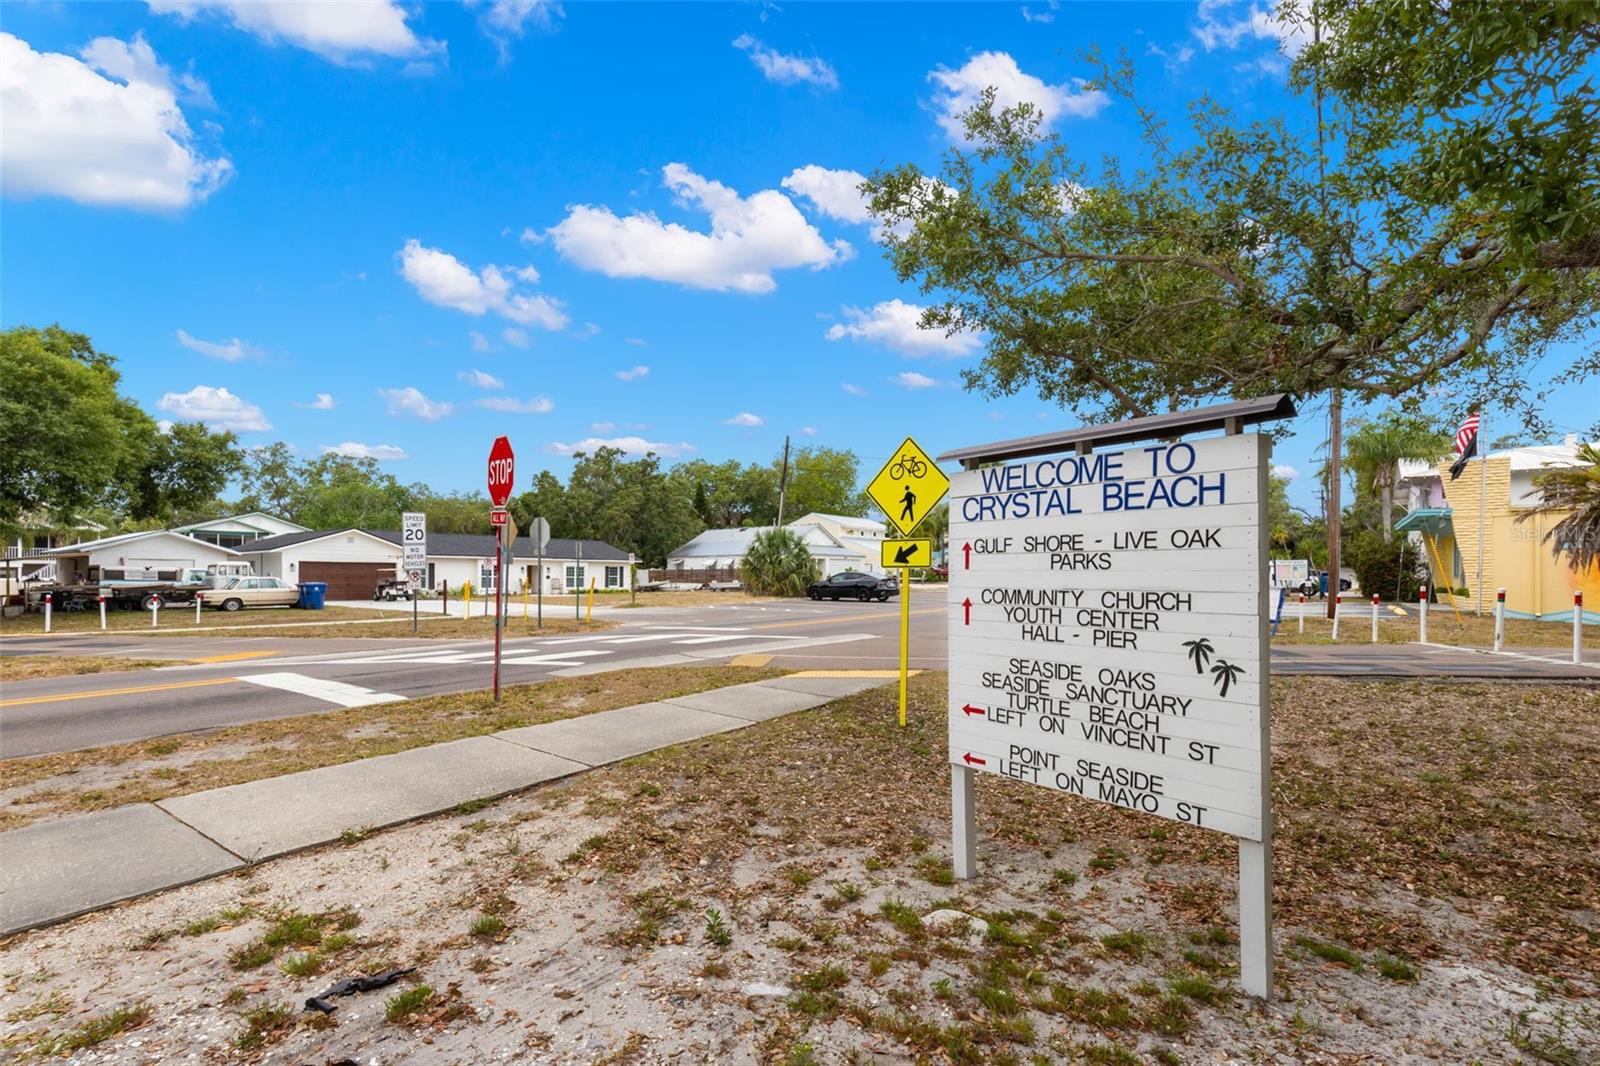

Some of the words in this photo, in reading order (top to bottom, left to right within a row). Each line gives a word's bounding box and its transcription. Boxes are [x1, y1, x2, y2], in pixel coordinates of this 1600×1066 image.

[489, 457, 513, 485] STOP
[981, 452, 1125, 493] WELCOME
[1144, 442, 1196, 476] TO
[963, 487, 1082, 522] CRYSTAL
[1103, 473, 1226, 511] BEACH
[405, 529, 424, 541] 20
[974, 537, 1012, 554] GULF
[1024, 534, 1084, 552] SHORE
[1114, 531, 1157, 549] LIVE
[1171, 528, 1221, 548] OAK
[1050, 553, 1111, 570] PARKS
[981, 589, 1083, 607] COMMUNITY
[1101, 592, 1191, 611] CHURCH
[1004, 607, 1062, 624] YOUTH
[1077, 610, 1159, 630] CENTER
[1022, 625, 1064, 643] HALL
[1093, 630, 1137, 649] PIER
[1009, 659, 1082, 682] SEASIDE
[1099, 668, 1155, 690] OAKS
[982, 673, 1049, 696] SEASIDE
[1066, 684, 1192, 716] SANCTUARY
[1006, 693, 1070, 717] TURTLE
[1090, 706, 1159, 733] BEACH
[988, 707, 1026, 727] LEFT
[1040, 716, 1064, 735] ON
[1081, 723, 1170, 754] VINCENT
[1189, 742, 1219, 764] ST
[1010, 745, 1060, 770] POINT
[1076, 760, 1164, 795] SEASIDE
[1000, 759, 1041, 783] LEFT
[1056, 773, 1083, 794] ON
[1099, 783, 1158, 813] MAYO
[1176, 803, 1207, 825] ST
